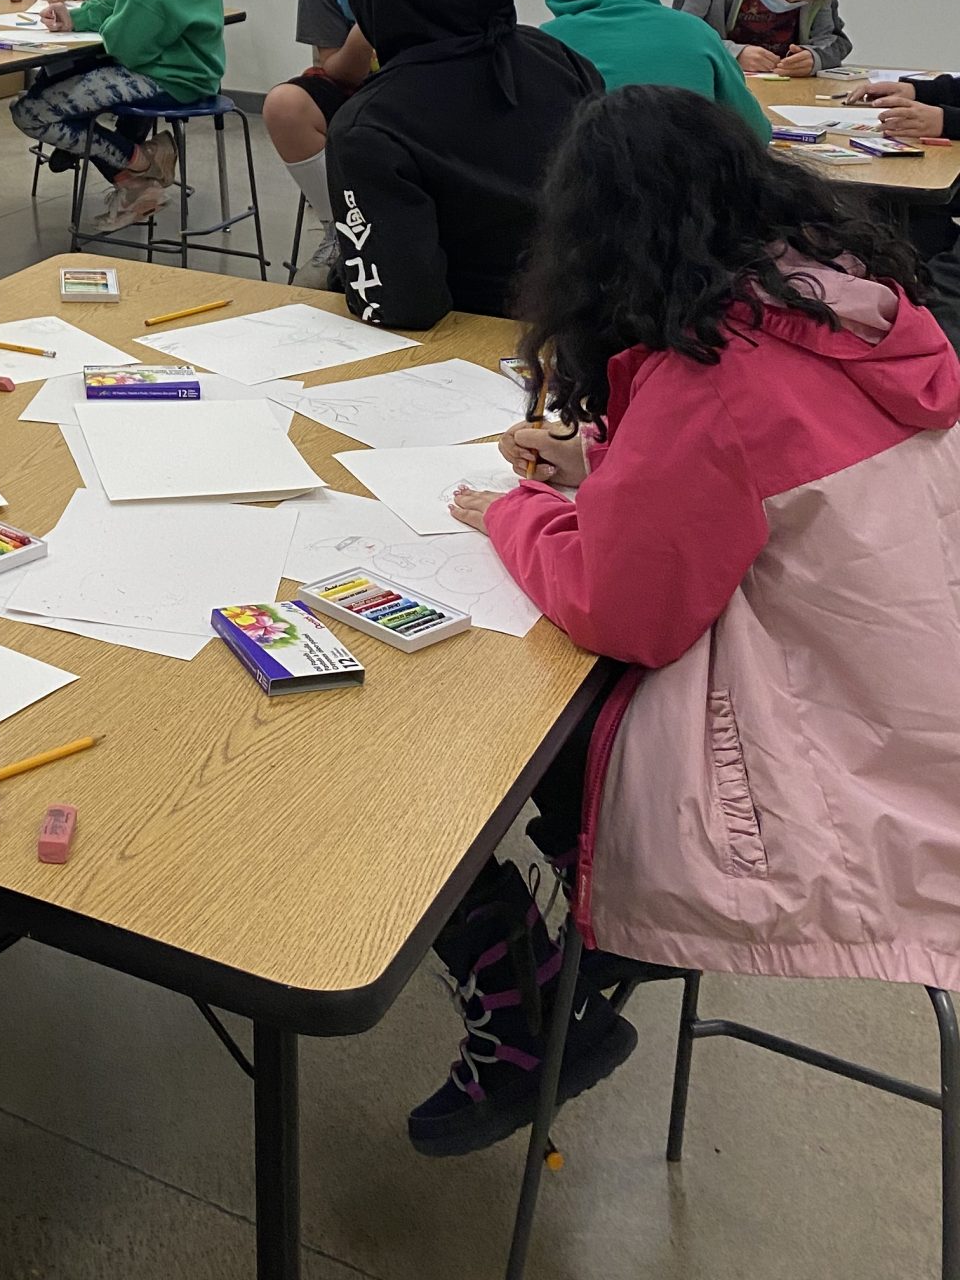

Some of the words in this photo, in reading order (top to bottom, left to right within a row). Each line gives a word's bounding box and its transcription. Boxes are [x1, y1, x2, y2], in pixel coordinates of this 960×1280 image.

[178, 389, 187, 397] 12
[338, 657, 360, 669] 12
[256, 669, 263, 684] 12
